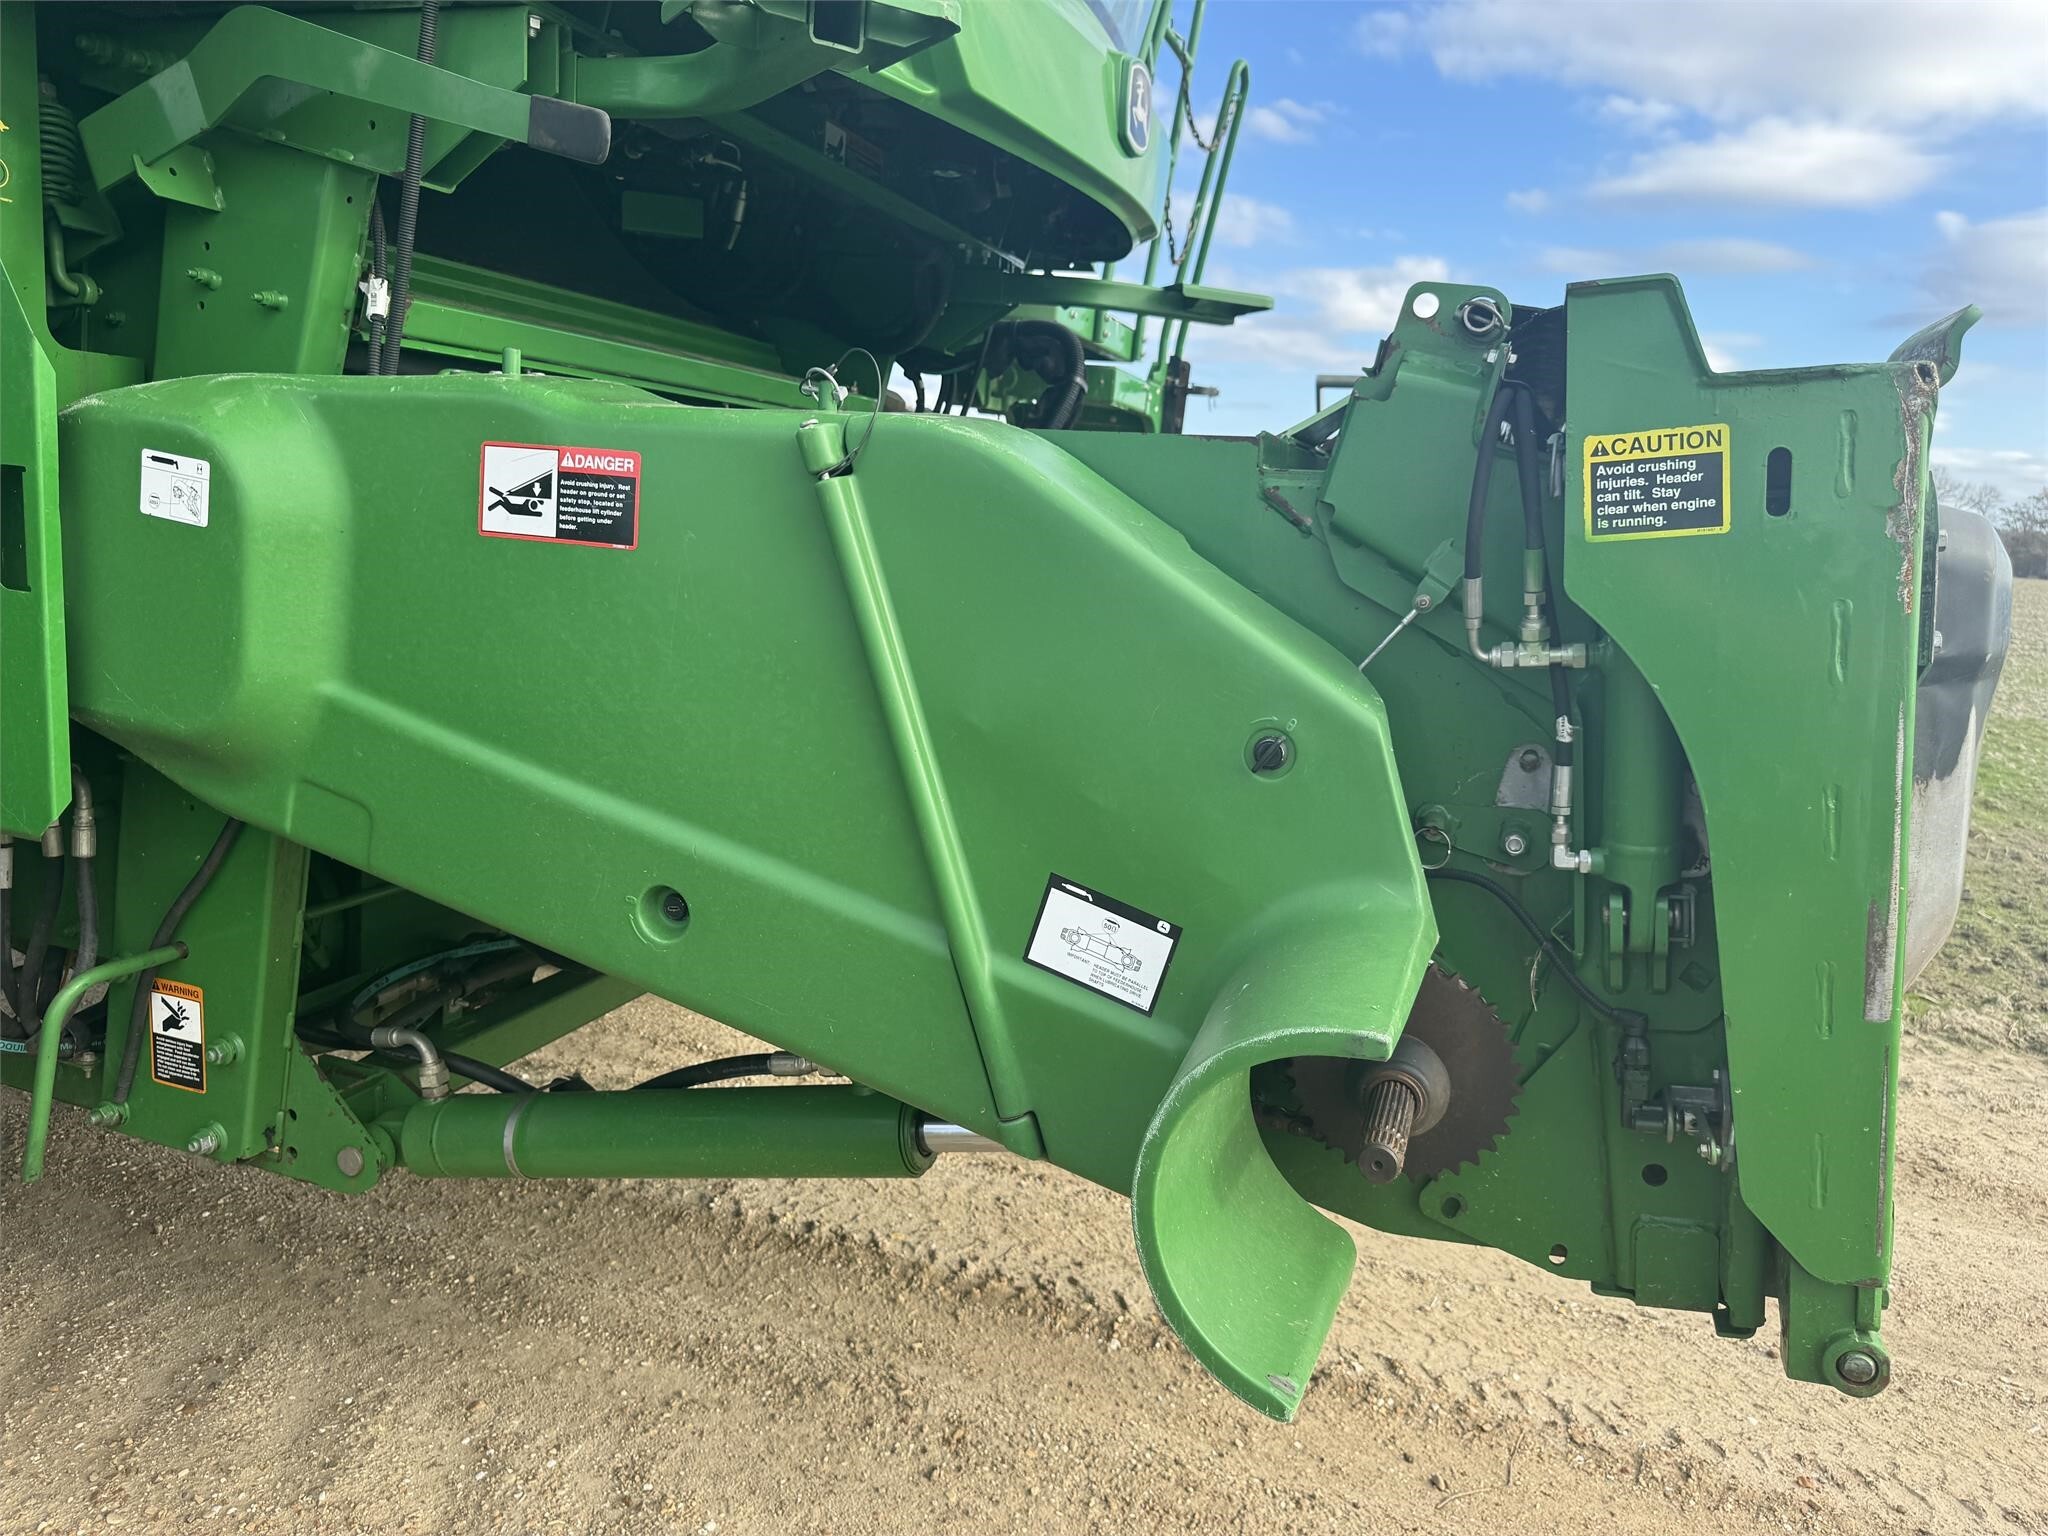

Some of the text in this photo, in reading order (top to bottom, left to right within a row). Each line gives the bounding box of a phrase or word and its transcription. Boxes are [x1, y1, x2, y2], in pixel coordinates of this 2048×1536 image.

[1611, 429, 1722, 455] CAUTION
[575, 454, 635, 472] DANGER
[1596, 459, 1697, 476] Avoid crushing
[576, 481, 599, 490] crushing
[1597, 472, 1704, 491] injuries. Header
[560, 497, 577, 505] safety
[1597, 487, 1681, 503] can tilt. Stay
[559, 505, 592, 514] feederhouse
[1597, 498, 1716, 516] clear when engine
[577, 516, 596, 524] getting
[1597, 515, 1667, 529] is running.
[161, 982, 199, 998] WARNING
